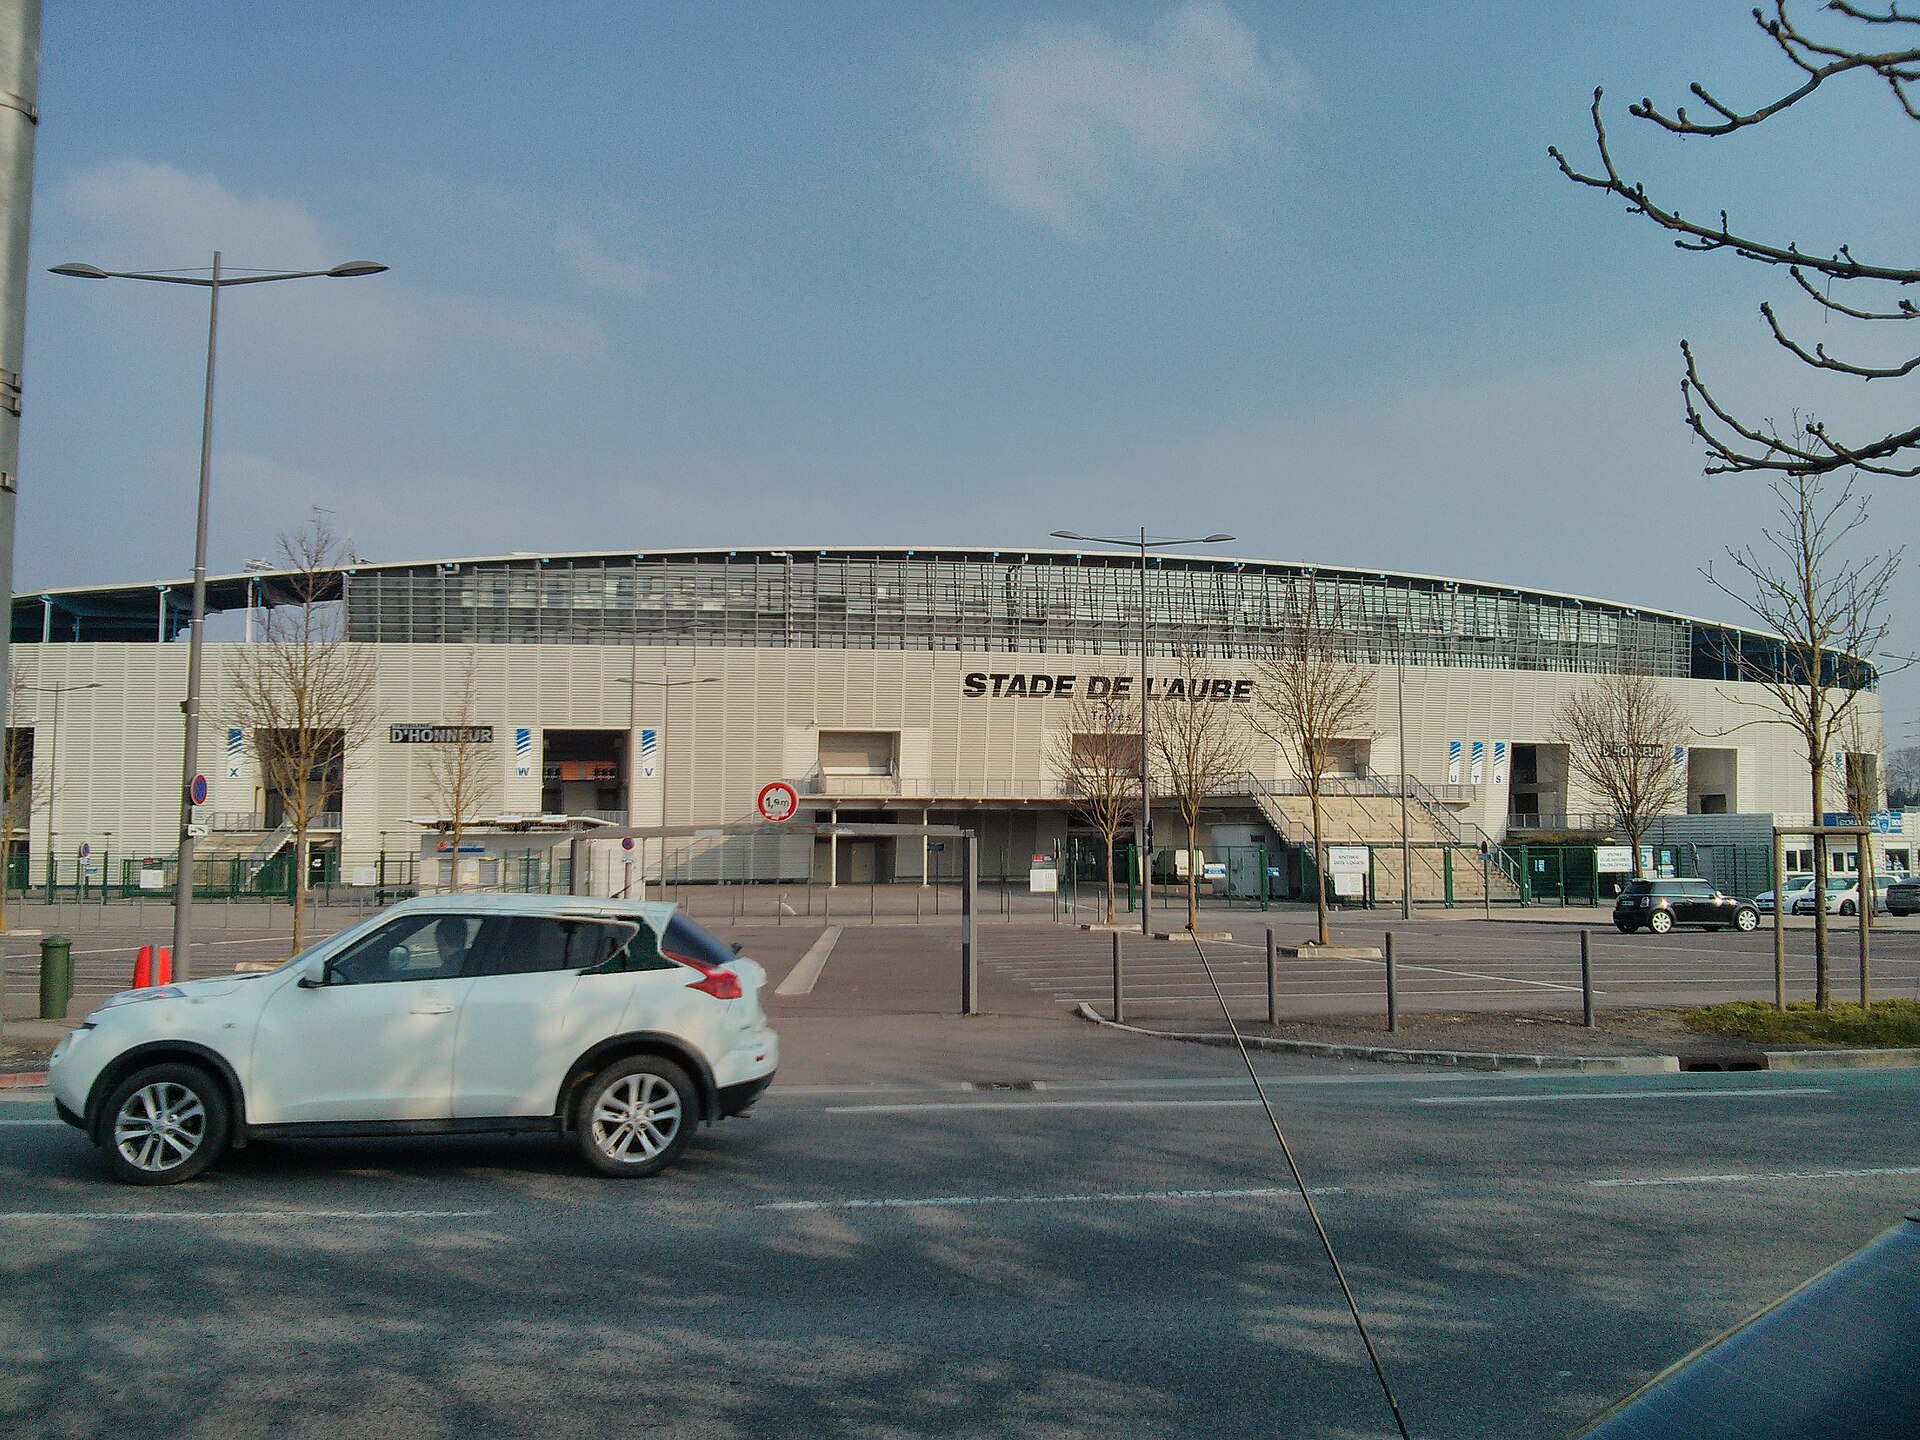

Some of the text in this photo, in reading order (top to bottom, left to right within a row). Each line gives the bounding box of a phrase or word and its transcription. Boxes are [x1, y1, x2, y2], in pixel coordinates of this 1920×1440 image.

[963, 673, 1255, 703] STADE DE L'AUBE
[392, 729, 492, 742] D'HONNEUR
[230, 767, 239, 777] X
[518, 767, 530, 776] W
[645, 768, 654, 777] V
[1450, 775, 1457, 783] U
[1473, 775, 1480, 783] T
[1495, 775, 1502, 783] S
